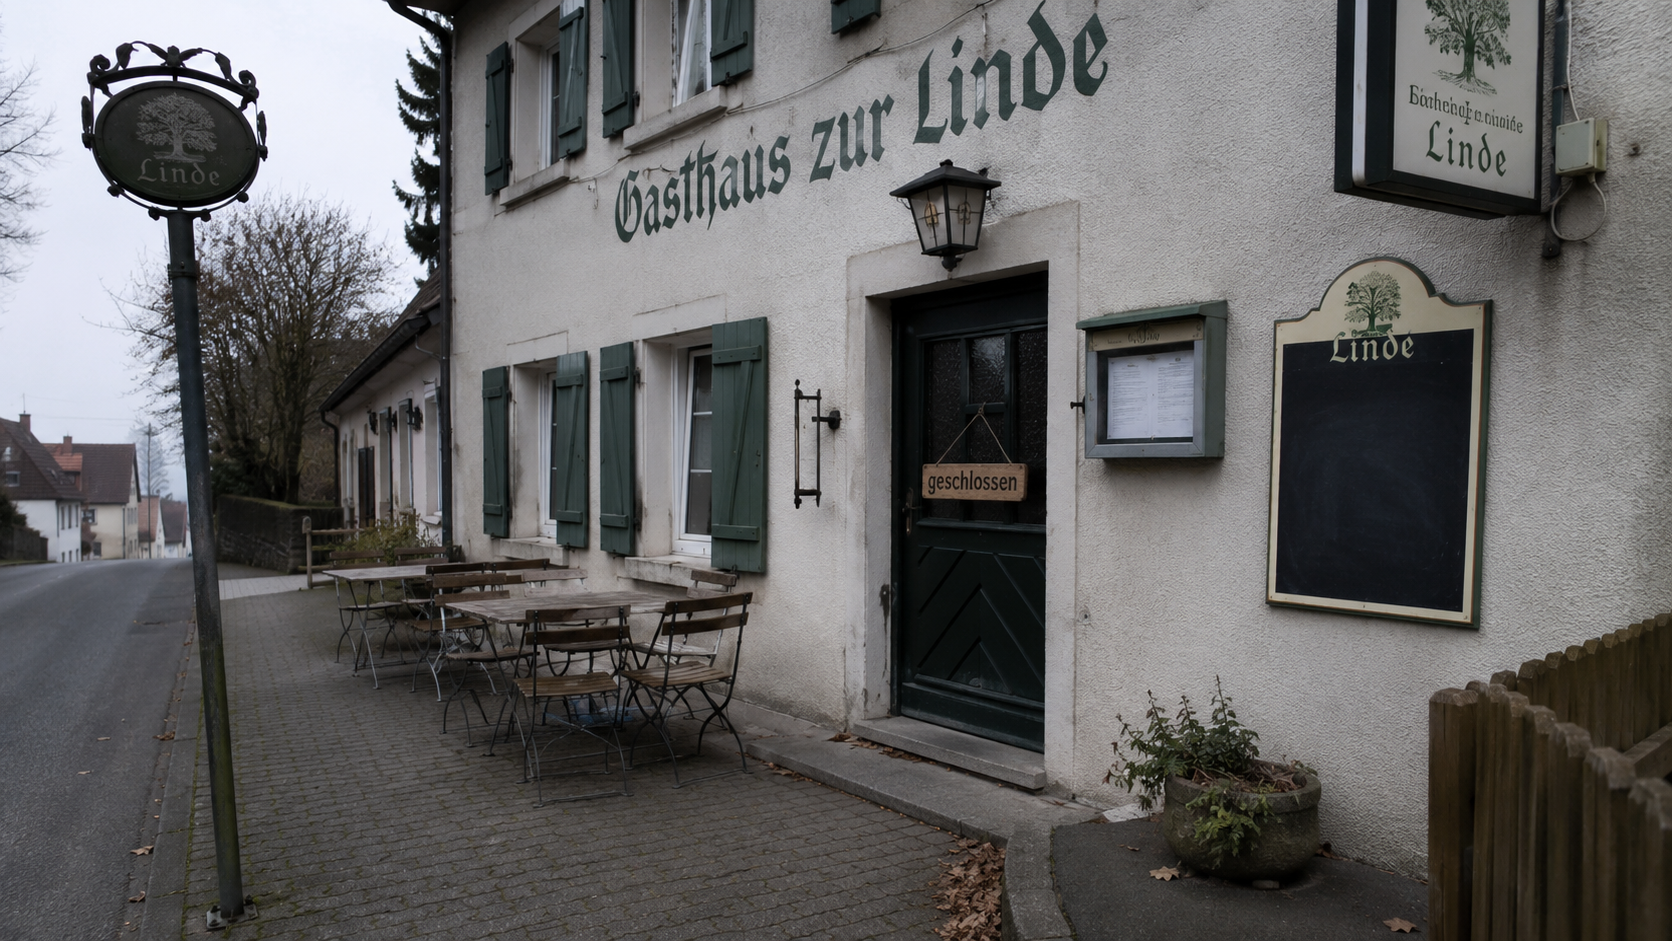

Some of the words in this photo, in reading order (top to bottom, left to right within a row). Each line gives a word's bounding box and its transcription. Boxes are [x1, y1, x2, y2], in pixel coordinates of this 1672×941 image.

[614, 135, 791, 243] Gasthaus
[809, 93, 895, 184] zur
[912, 0, 1108, 145] Linde
[1425, 119, 1507, 178] Linde
[136, 158, 220, 186] Linde
[1329, 329, 1415, 363] Linde
[927, 470, 1018, 495] geschlossen
